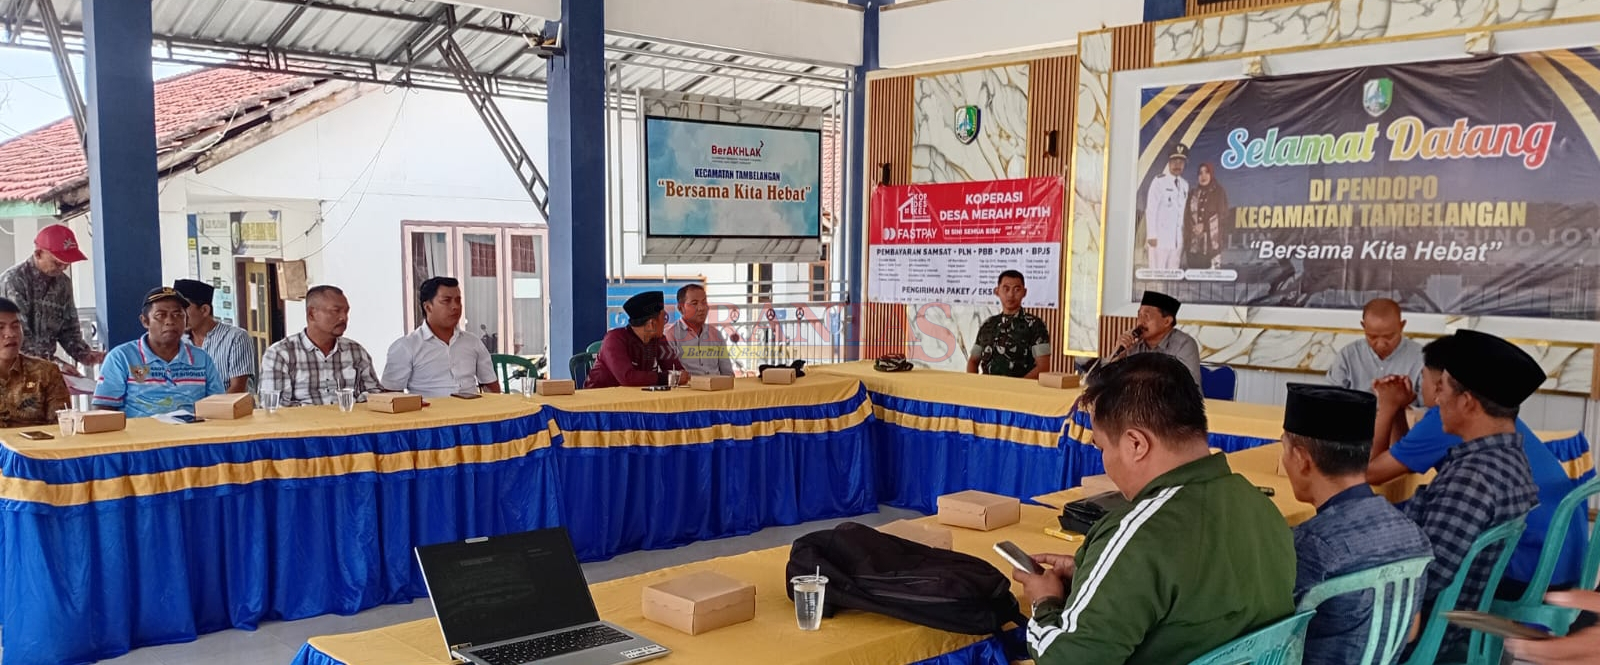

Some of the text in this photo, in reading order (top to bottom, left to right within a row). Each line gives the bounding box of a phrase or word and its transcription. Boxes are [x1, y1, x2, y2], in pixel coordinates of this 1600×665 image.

[1221, 115, 1556, 170] Selamat Datang
[711, 145, 762, 158] BerAKHLAK
[694, 168, 781, 181] KECAMATAN TAMBELANGAN
[734, 183, 763, 200] Kita
[1309, 175, 1438, 202] DI PENDOPO
[965, 191, 1023, 205] KOPERASI
[939, 205, 1051, 221] DESA MERAH PUTIH
[1235, 201, 1527, 229] KECAMATAN TAMBELANGAN
[897, 227, 938, 240] FASTPAY
[876, 246, 1051, 256] PEMBAYARAN SAMSAT PLN PBB PDAM BPJS
[1360, 240, 1407, 260] Kita
[902, 286, 945, 295] PENGIRIMAN
[946, 287, 971, 295] PAKET
